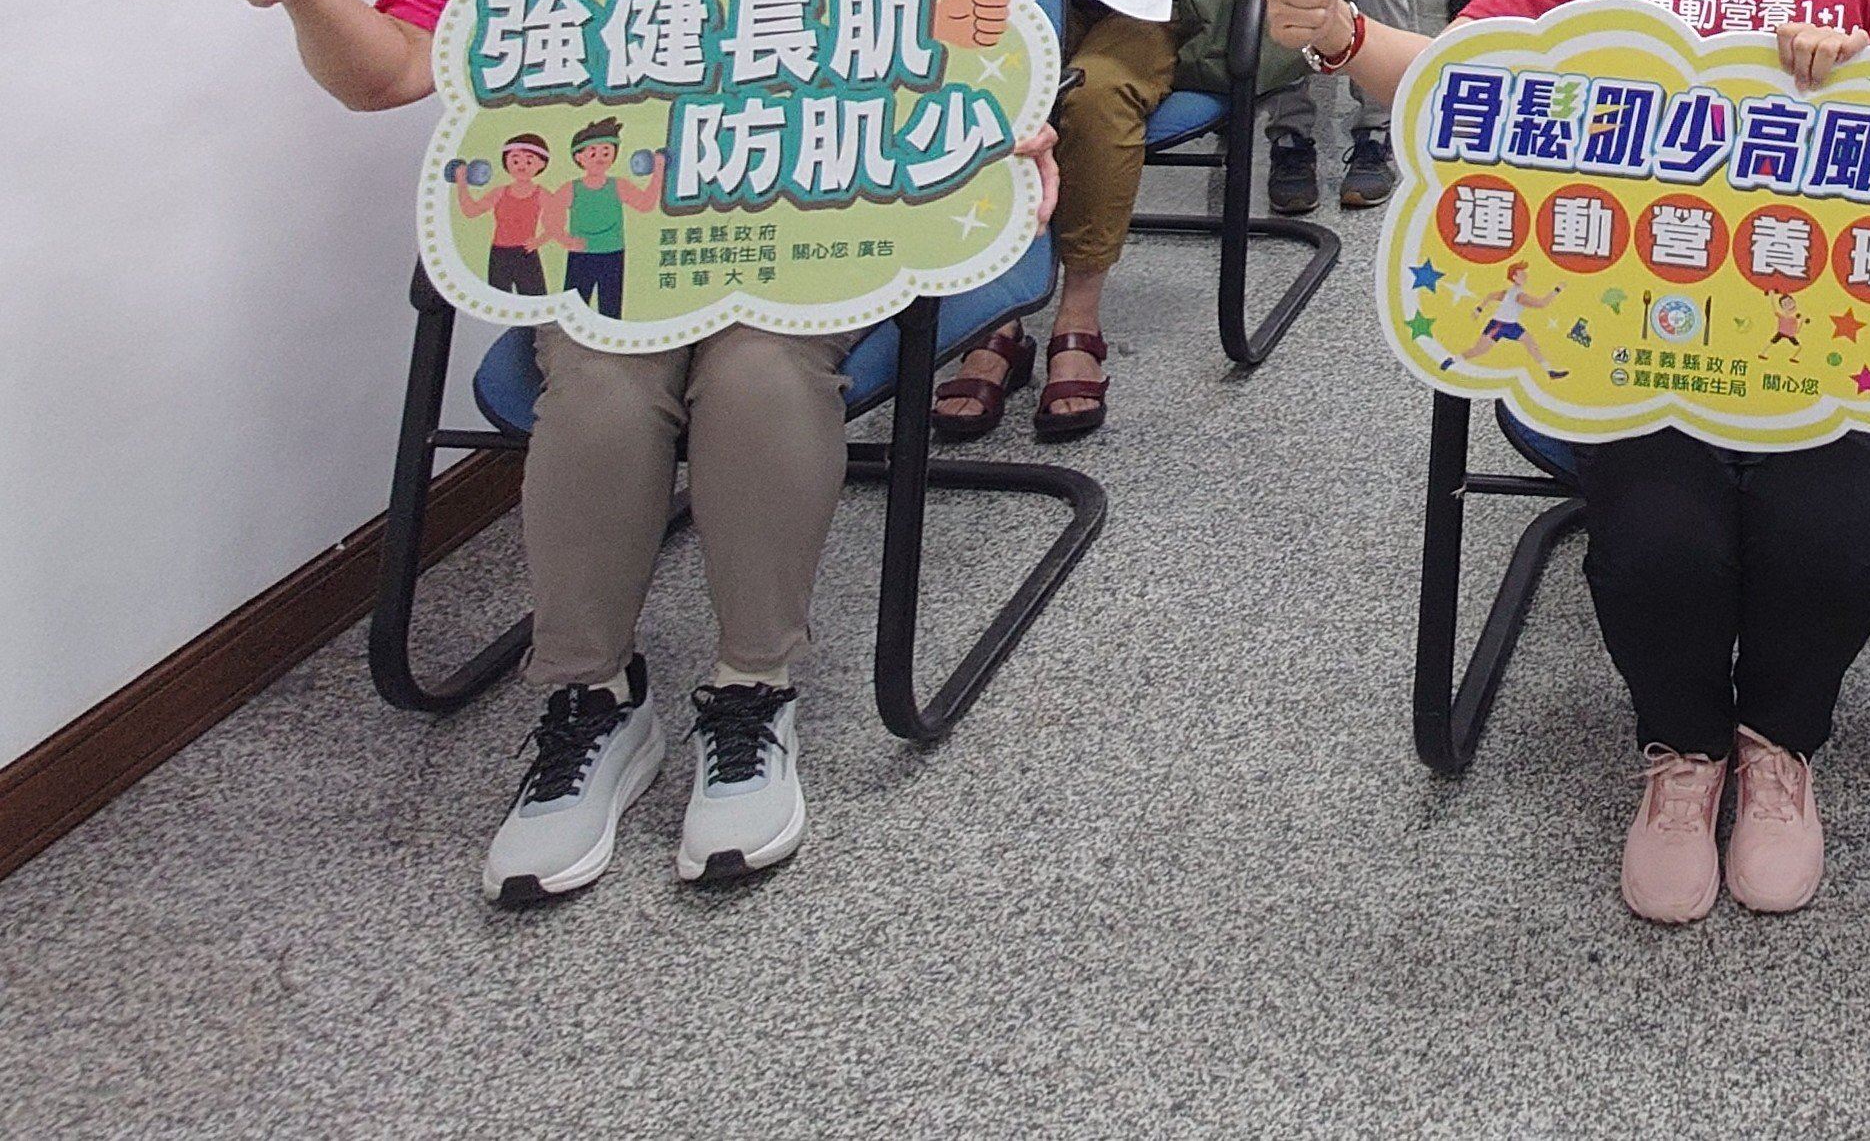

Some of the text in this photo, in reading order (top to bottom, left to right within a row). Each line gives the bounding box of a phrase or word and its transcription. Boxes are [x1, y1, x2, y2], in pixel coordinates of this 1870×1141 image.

[676, 95, 1006, 199] 防肌少
[659, 224, 777, 244] 嘉義縣政府
[658, 239, 895, 267] 嘉義縣衛生局 關心您 廣告
[659, 267, 777, 289] 南華大學
[1634, 348, 1748, 376] 嘉義縣政府
[1632, 369, 1820, 398] 嘉義縣衛生局 關心您
